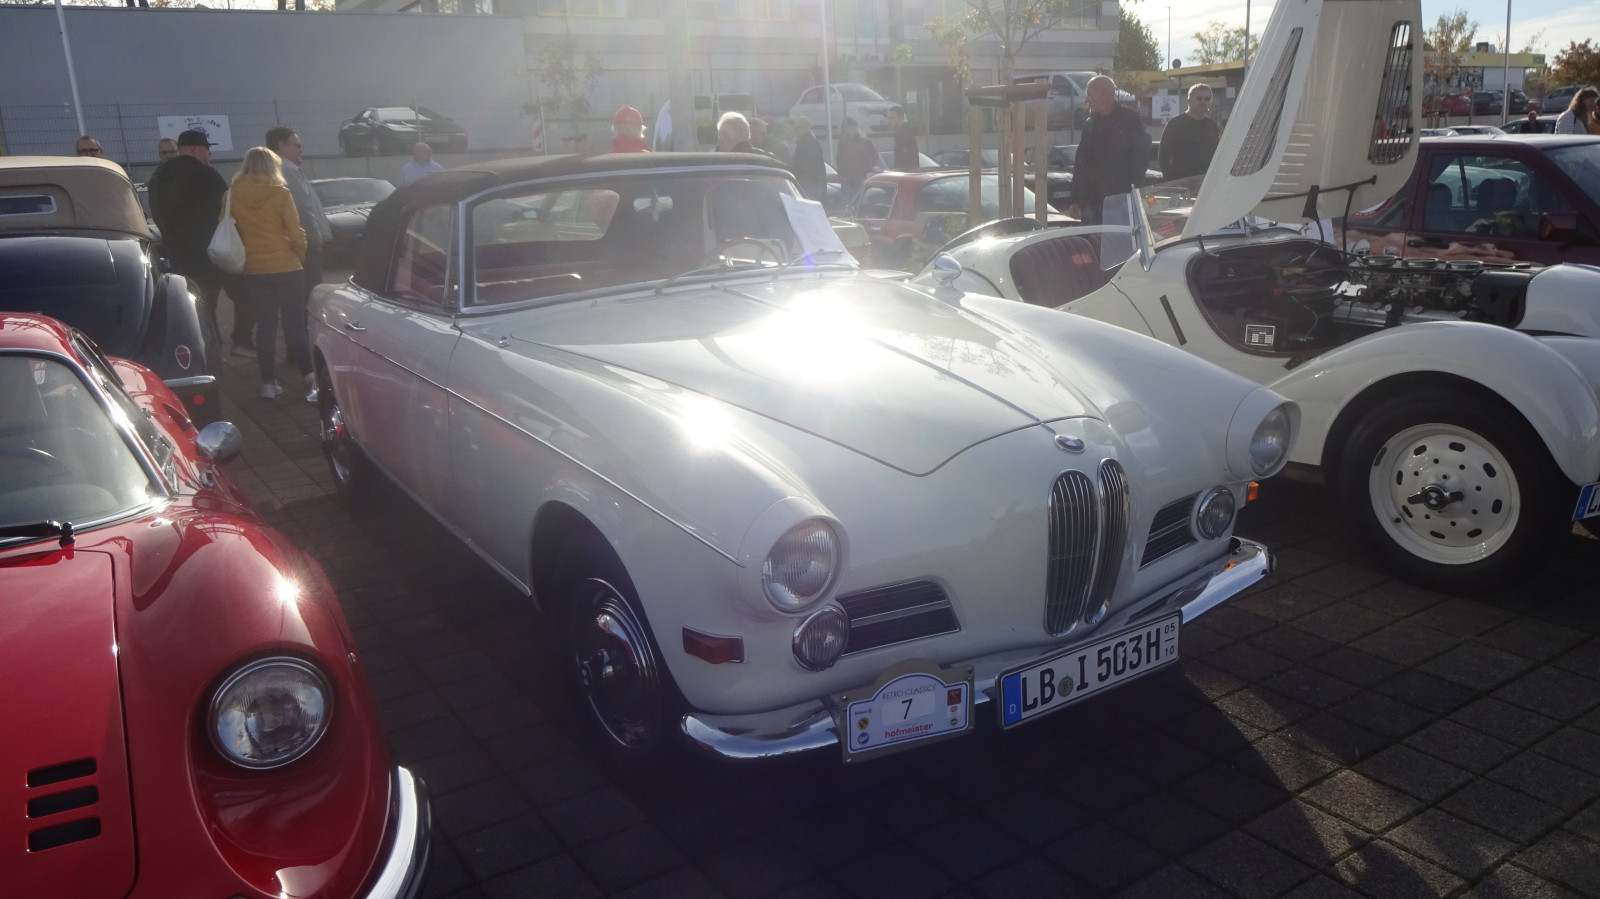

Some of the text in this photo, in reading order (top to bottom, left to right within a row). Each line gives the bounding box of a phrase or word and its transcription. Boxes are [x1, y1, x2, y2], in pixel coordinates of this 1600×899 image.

[1164, 622, 1176, 634] 05
[1164, 645, 1175, 657] 10
[1009, 628, 1161, 715] D LB I 503H
[882, 683, 937, 701] RETRO CLASSICS
[901, 698, 913, 720] 7
[884, 723, 934, 738] hofmeister
